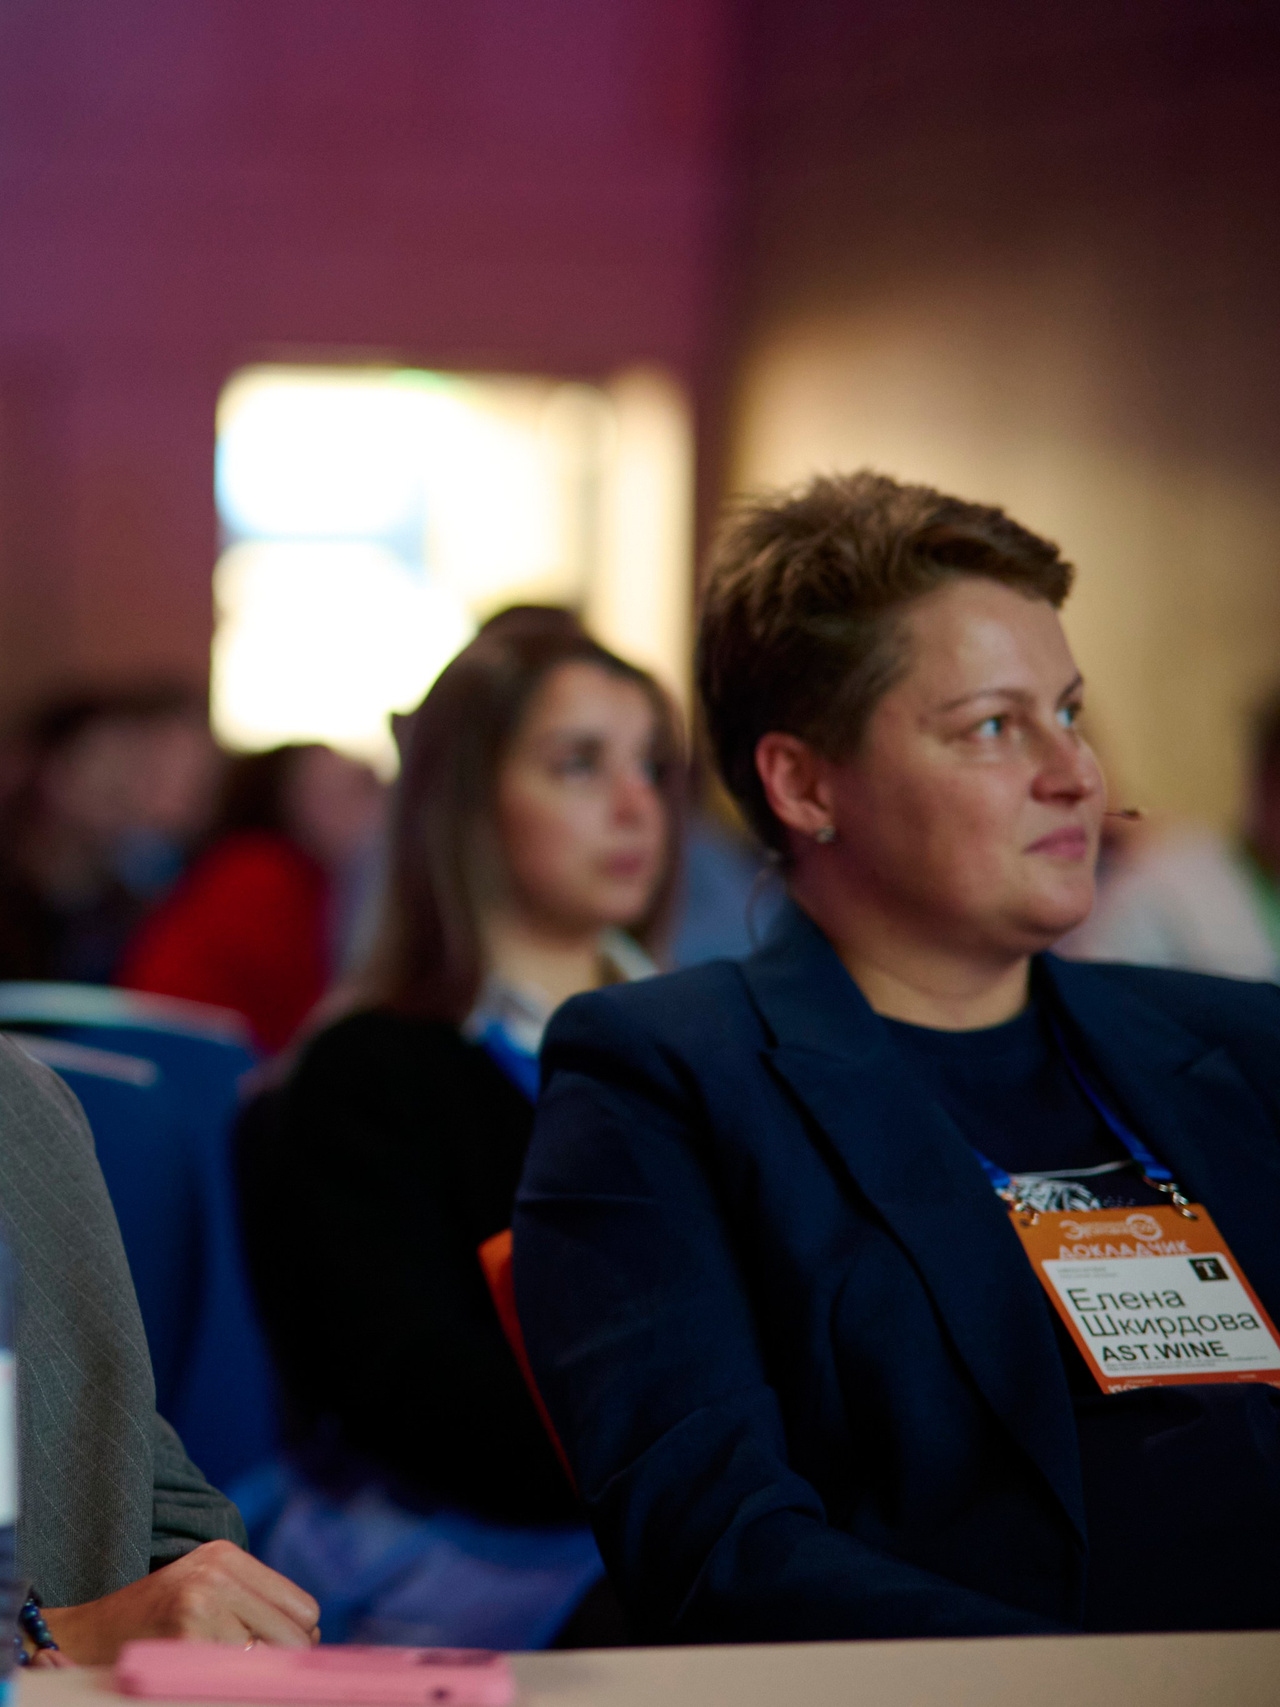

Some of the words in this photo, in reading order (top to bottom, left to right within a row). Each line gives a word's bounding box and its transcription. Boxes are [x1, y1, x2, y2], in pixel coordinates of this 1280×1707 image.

[1067, 1288, 1185, 1312] Елена
[1081, 1312, 1260, 1340] Шкирдова
[1102, 1341, 1229, 1362] AST.WINE
